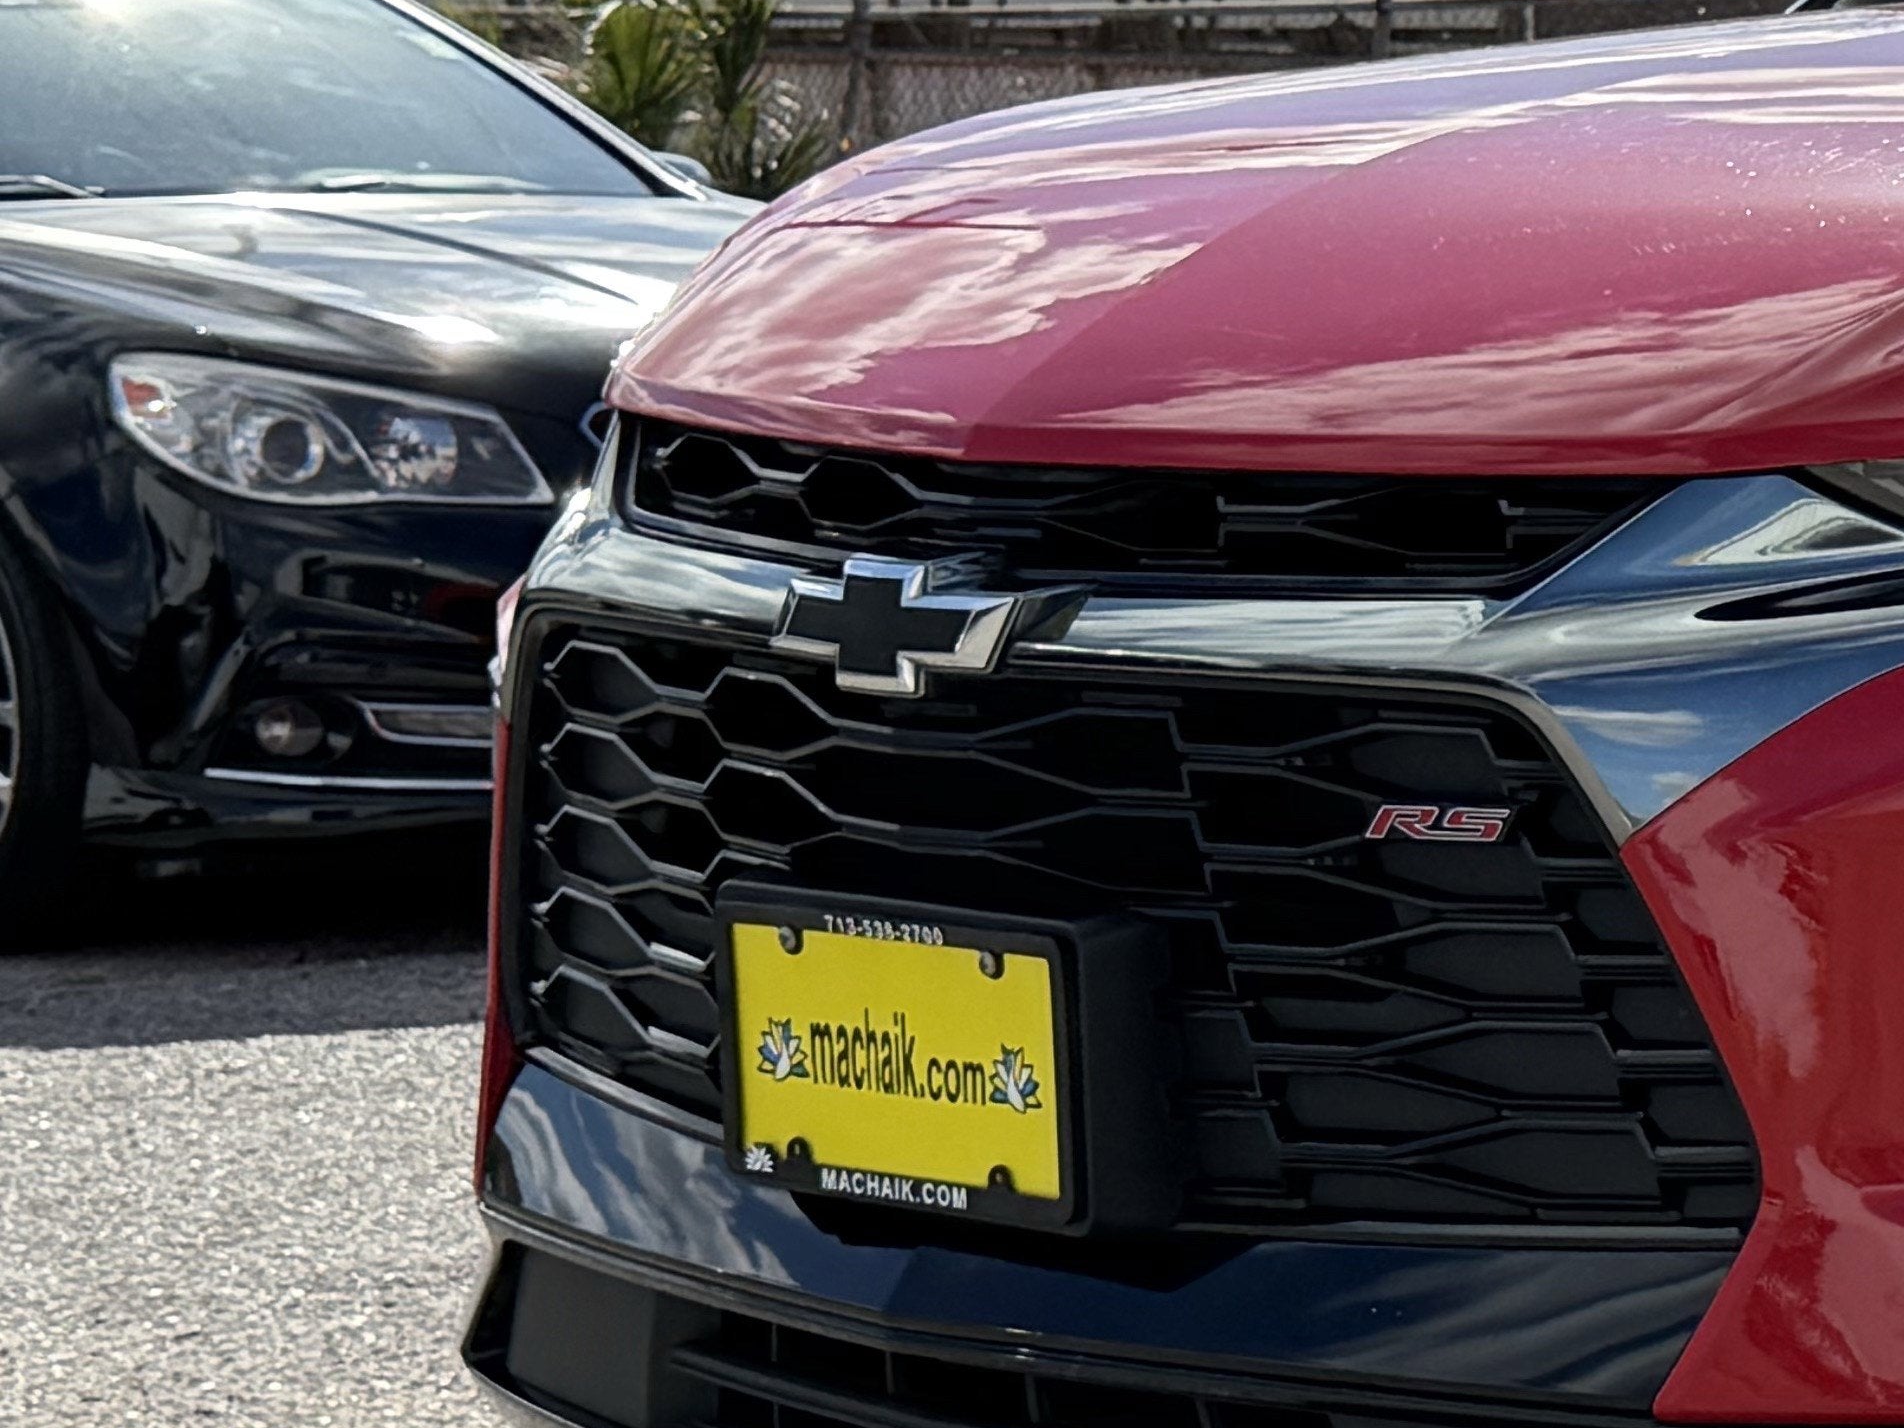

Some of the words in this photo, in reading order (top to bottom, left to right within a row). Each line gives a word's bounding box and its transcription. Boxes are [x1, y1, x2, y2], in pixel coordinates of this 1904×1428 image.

[1365, 804, 1511, 842] RS
[809, 1007, 988, 1107] machaik.com
[820, 1167, 969, 1211] MACHAIK.COM
